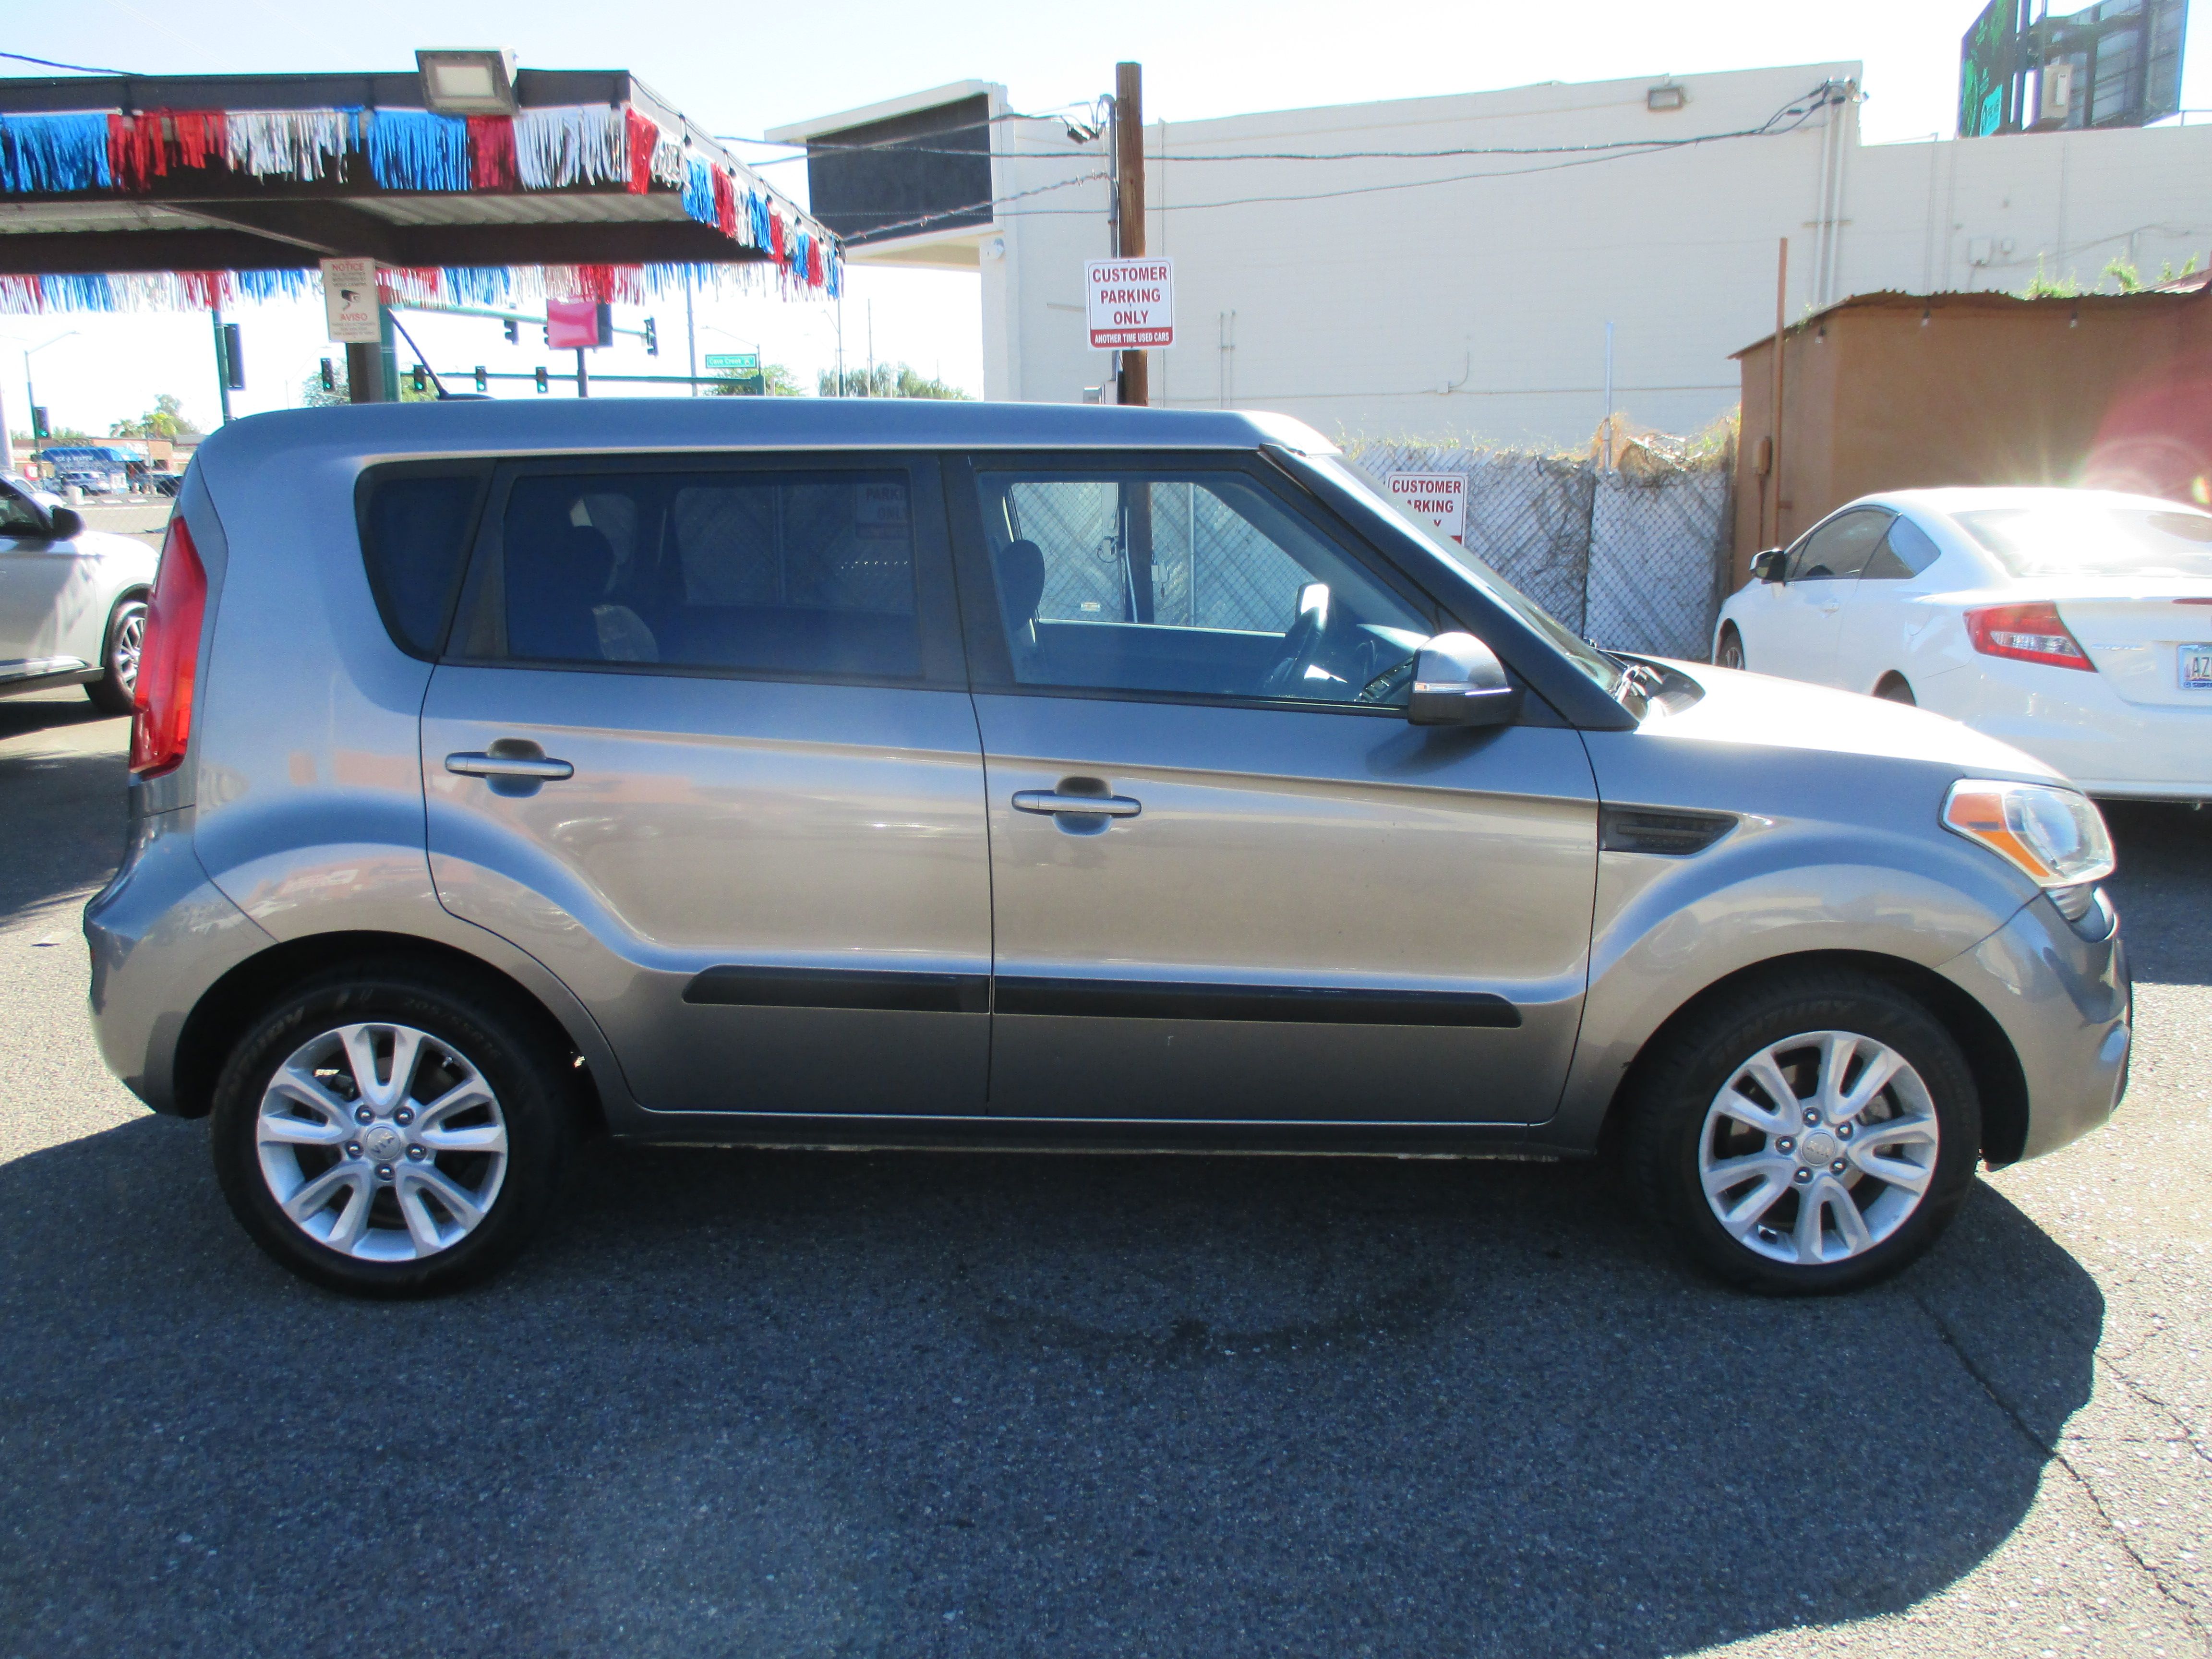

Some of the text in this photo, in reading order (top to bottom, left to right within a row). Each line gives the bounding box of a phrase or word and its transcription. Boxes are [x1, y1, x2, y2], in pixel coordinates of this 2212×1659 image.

[332, 263, 365, 271] NOTICE
[1092, 266, 1167, 283] CUSTOMER
[1100, 288, 1161, 304] PARKING
[340, 313, 368, 322] AVISO
[1113, 310, 1149, 325] ONLY
[1094, 331, 1170, 344] ANOTHER TIME USED CARS
[1392, 480, 1461, 494] CUSTOMER
[1407, 499, 1454, 513] RKING
[2191, 657, 2212, 678] AZ
